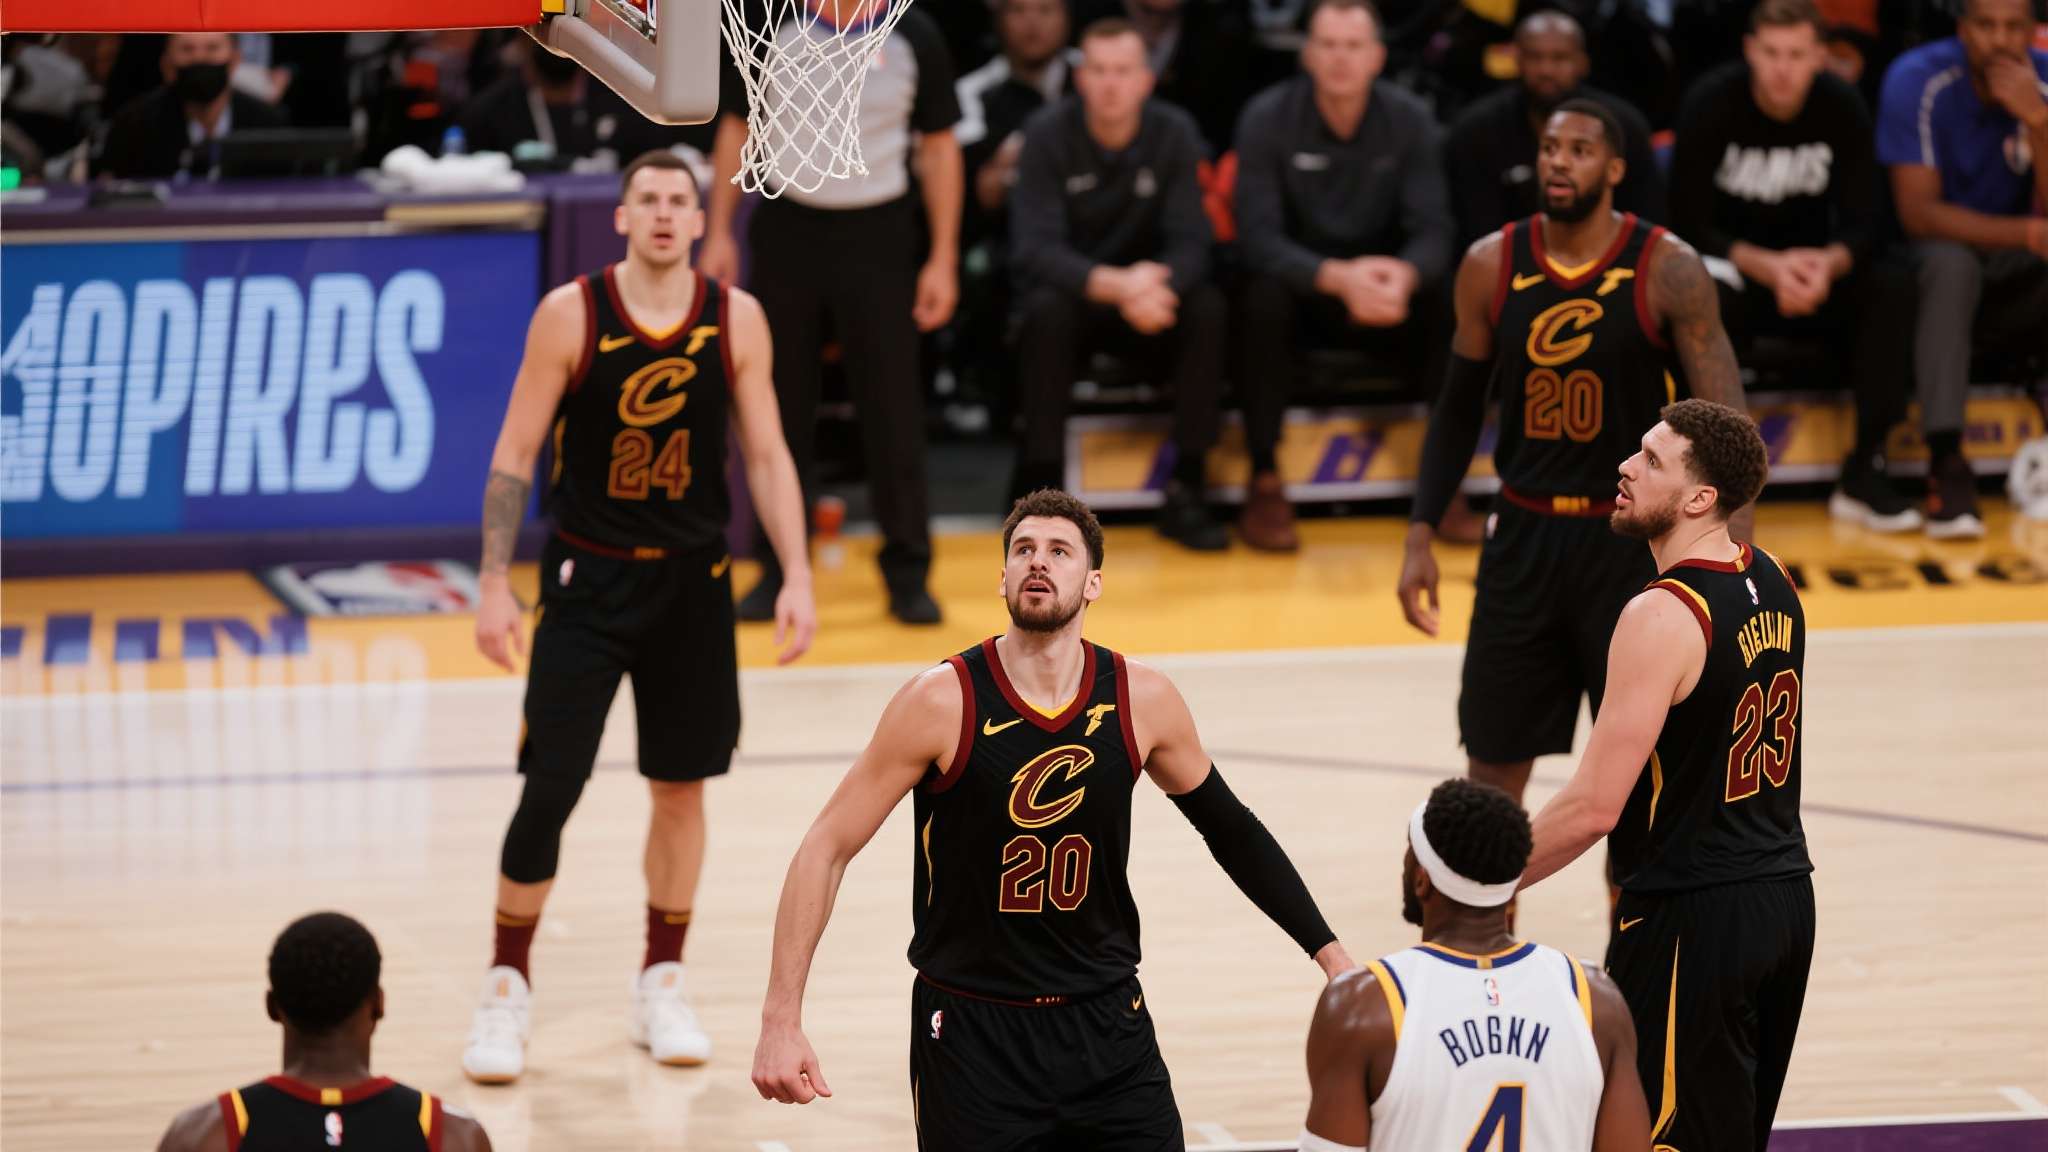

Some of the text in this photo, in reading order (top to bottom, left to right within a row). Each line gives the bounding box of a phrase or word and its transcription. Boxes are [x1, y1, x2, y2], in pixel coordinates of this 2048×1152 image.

[1525, 367, 1604, 443] 20
[607, 427, 692, 500] 24
[1725, 669, 1800, 802] 23
[999, 834, 1091, 912] 20
